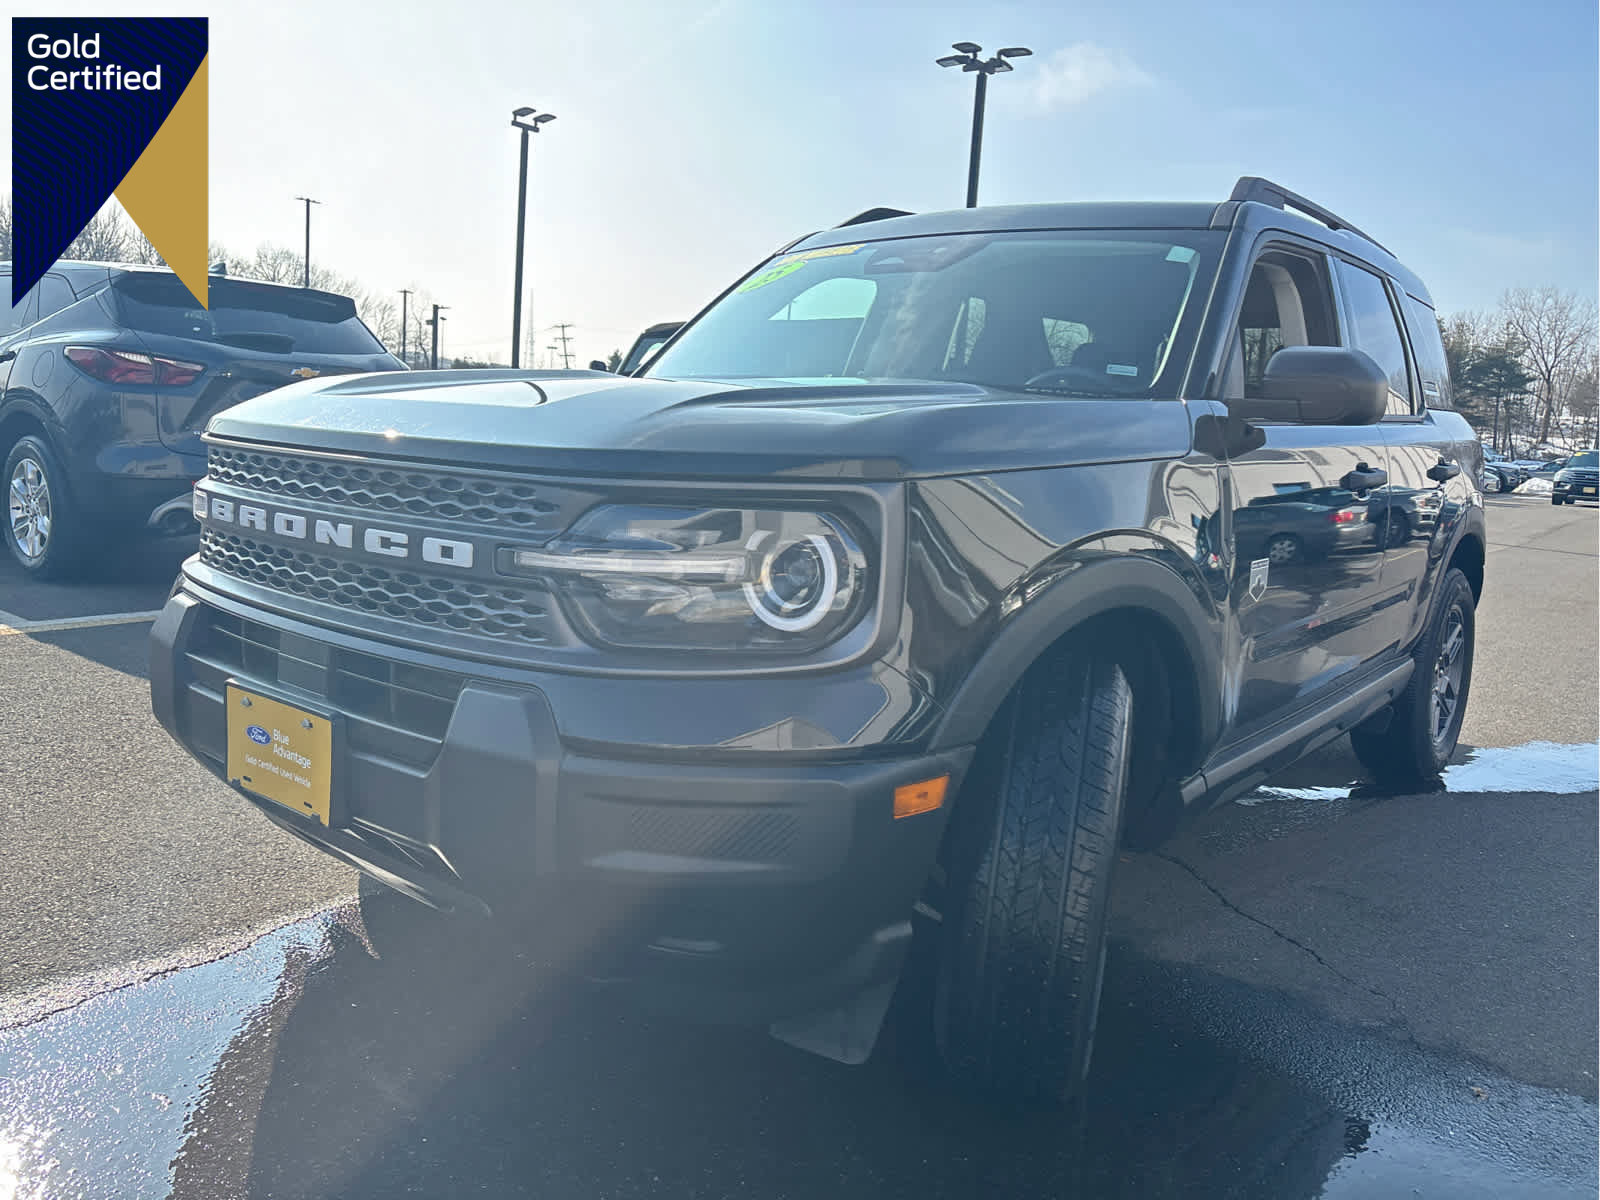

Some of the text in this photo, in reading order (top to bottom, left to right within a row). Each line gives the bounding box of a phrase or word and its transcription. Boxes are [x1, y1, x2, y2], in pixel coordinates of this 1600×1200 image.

[212, 498, 473, 568] BRONCO
[273, 728, 290, 745] Blue
[273, 743, 312, 769] Advantage
